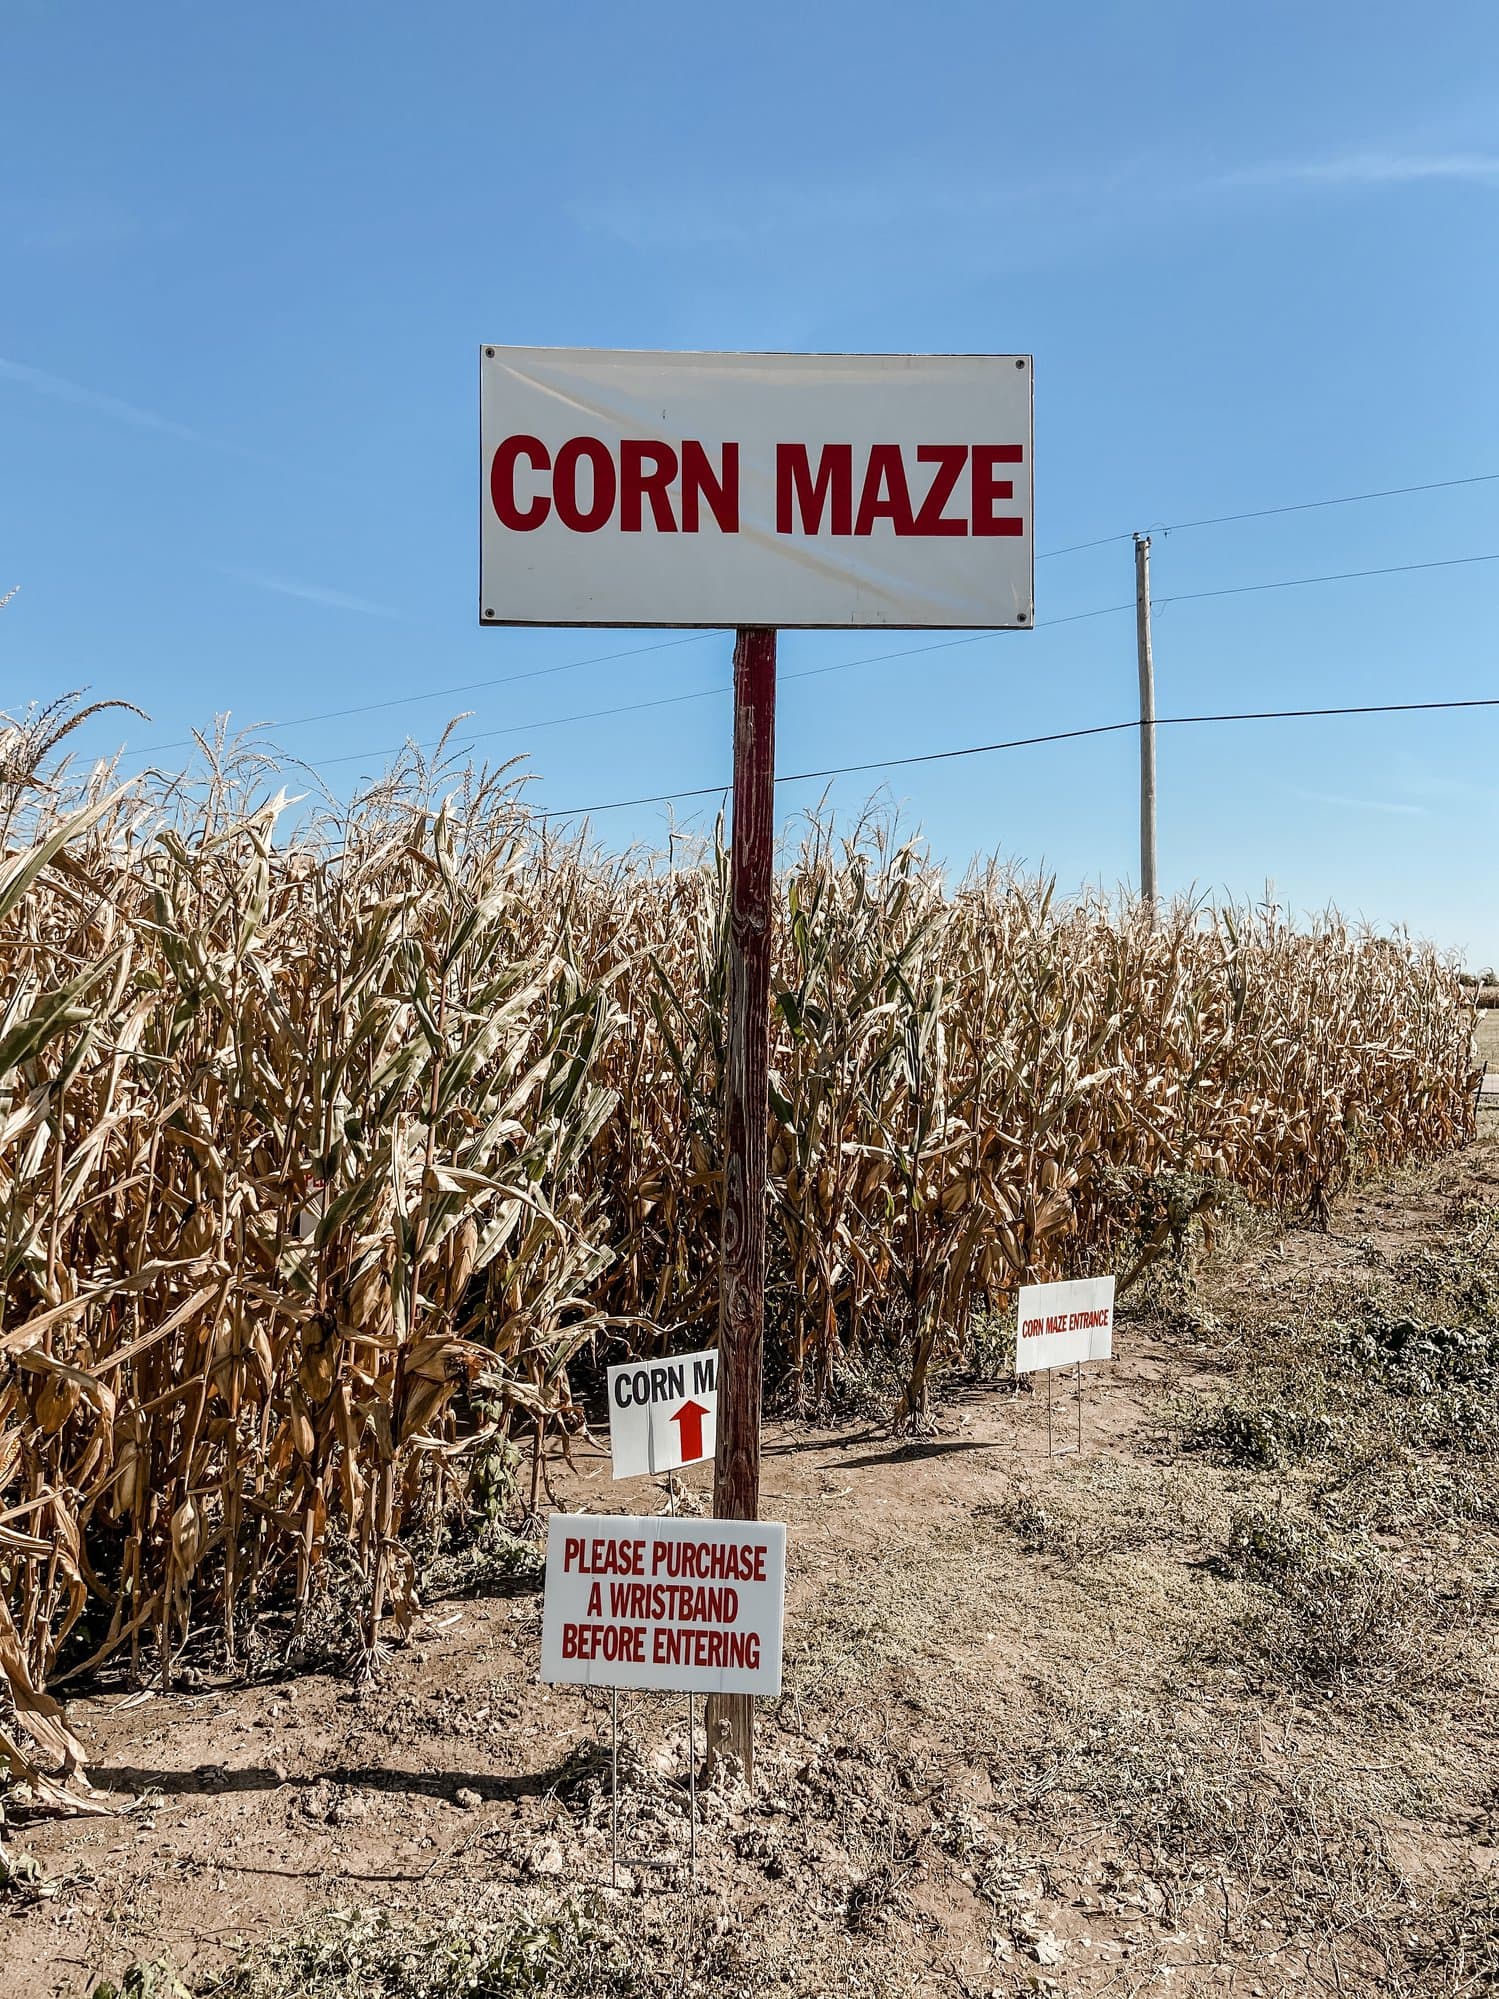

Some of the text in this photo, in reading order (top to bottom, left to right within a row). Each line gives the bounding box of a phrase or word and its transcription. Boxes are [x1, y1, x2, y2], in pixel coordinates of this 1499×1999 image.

[490, 435, 1023, 537] CORN MAZE
[1022, 1309, 1109, 1338] CORN MAZE ENTRANCE
[614, 1364, 685, 1408] CORN
[564, 1538, 767, 1582] PLEASE PURCHASE
[587, 1582, 738, 1624] A WRISTBAND
[562, 1623, 760, 1670] BEFORE ENTERING
